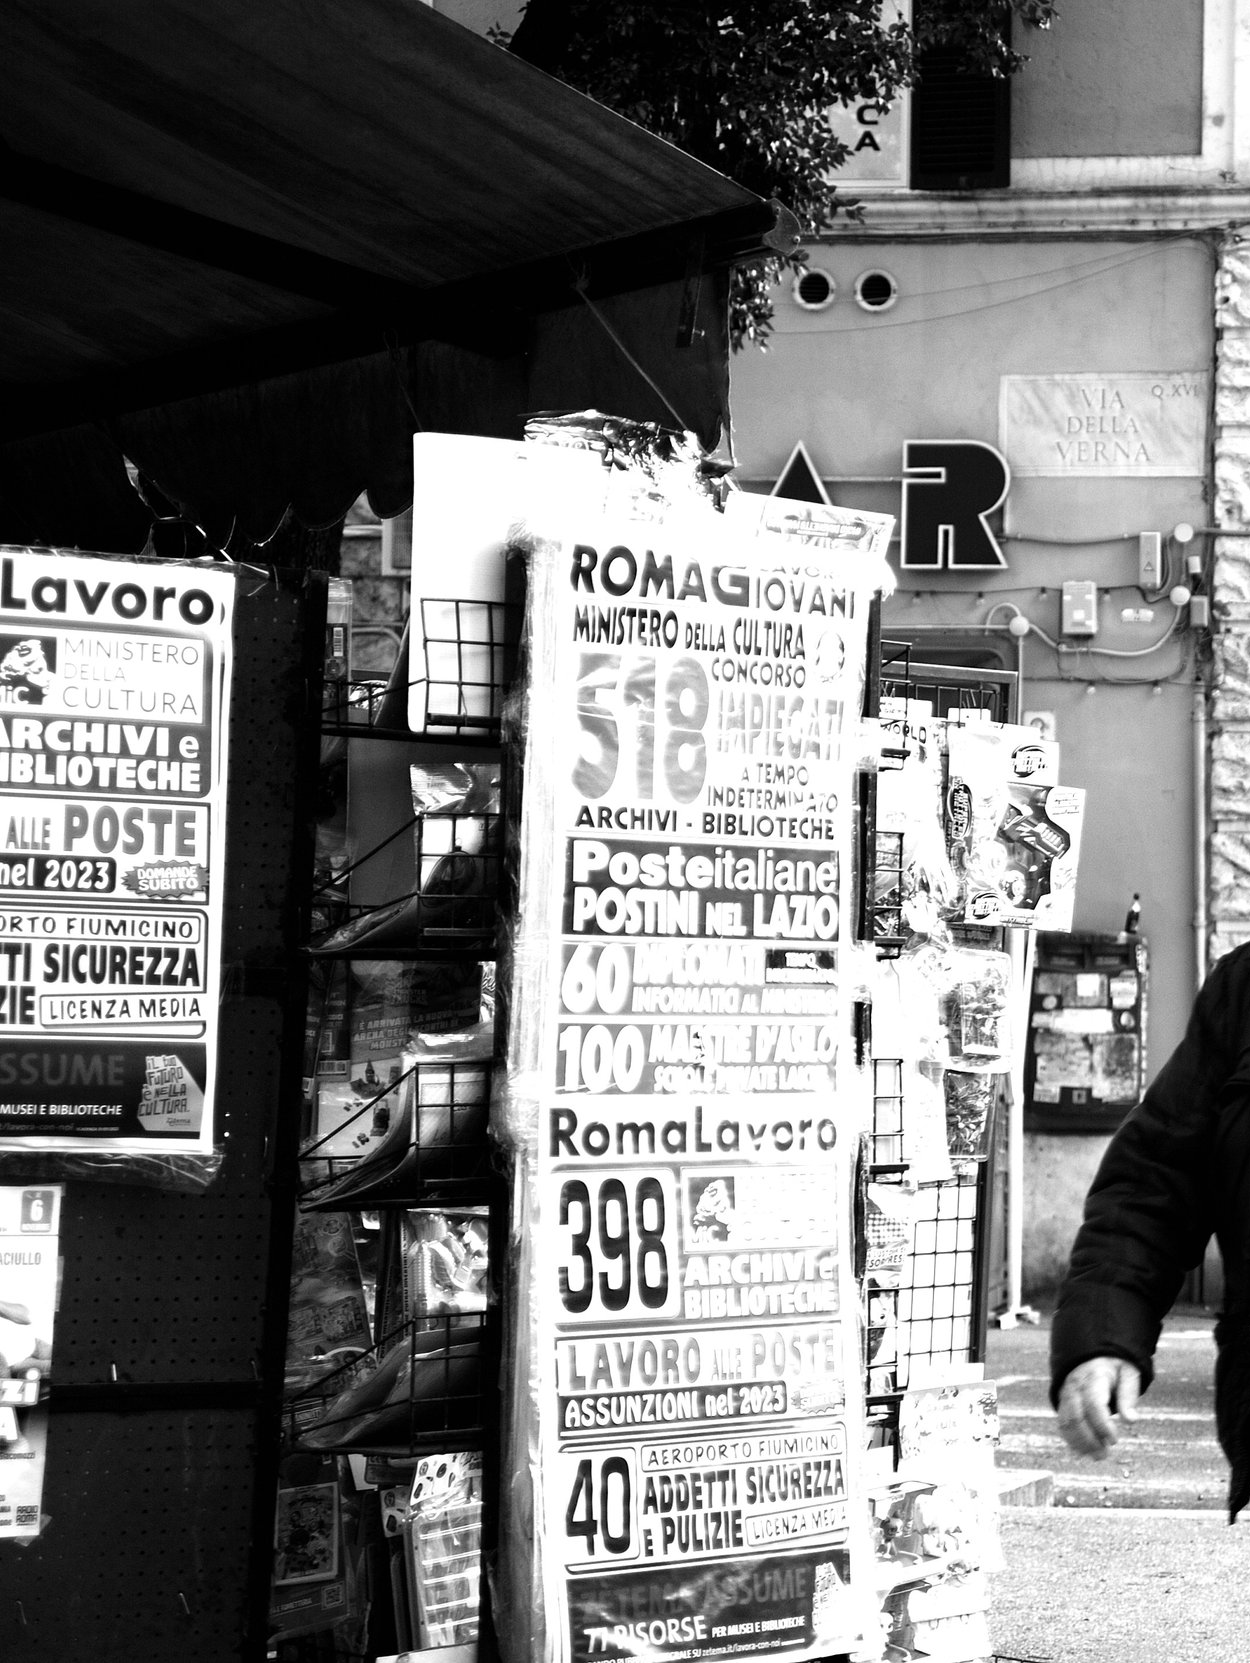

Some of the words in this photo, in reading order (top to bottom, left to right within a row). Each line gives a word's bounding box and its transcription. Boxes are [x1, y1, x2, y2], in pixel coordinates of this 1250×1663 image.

[1081, 388, 1125, 409] VIA
[1067, 415, 1139, 434] DELLA
[1055, 441, 1151, 462] VERNA
[572, 605, 678, 648] MINISTERO
[685, 623, 726, 652] DELLA
[733, 617, 806, 660] CULTURA
[63, 638, 199, 665] MINISTERO
[63, 662, 127, 682] DELLA
[711, 657, 806, 688] CONCORSO
[62, 686, 198, 716] CULTURA
[0, 718, 169, 757] RCHIVI
[179, 736, 200, 758] e
[571, 652, 710, 805] 518
[741, 767, 750, 782] A
[756, 762, 809, 786] TEMPO
[6, 816, 51, 850] ALLE
[64, 804, 196, 857] POSTE
[574, 805, 678, 832] ARCHIVI
[702, 812, 835, 840] BIBLIOTECHE
[44, 860, 109, 889] 2023
[137, 866, 197, 880] DOMANDE
[138, 878, 199, 890] SUBITO
[66, 917, 193, 938] FIUMICINO
[572, 886, 700, 936] POSTINI
[705, 902, 747, 936] NEL
[753, 894, 839, 940] LAZIO
[43, 943, 200, 986] SICUREZZA
[561, 942, 631, 1014] 60
[50, 999, 131, 1020] LICENZA
[139, 998, 201, 1018] MEDIA
[559, 1024, 645, 1093] 100
[0, 1104, 37, 1115] MUSEI
[40, 1104, 46, 1115] E
[49, 1104, 123, 1116] BIBLIOTECHE
[31, 1200, 44, 1221] 6
[558, 1177, 669, 1313] 398
[683, 1252, 815, 1286] ARCHIVI
[684, 1281, 838, 1320] BIBLIOTECHE
[568, 1336, 701, 1391] LAVORO
[711, 1347, 742, 1381] ALLE
[751, 1328, 836, 1378] POSTE
[565, 1390, 700, 1428] ASSUNZIONI
[705, 1388, 733, 1417] nel
[739, 1385, 785, 1415] 2023
[648, 1442, 752, 1466] AEROPORTO
[758, 1434, 839, 1457] FIUMICINO
[643, 1468, 738, 1515] ADDETTI
[746, 1459, 844, 1505] SICUREZZA
[565, 1456, 631, 1556] 40
[661, 1510, 743, 1555] PULIZIE
[752, 1514, 807, 1540] LICENZA
[811, 1506, 846, 1529] MEDA
[613, 1615, 707, 1651] RISORSE
[712, 1626, 727, 1638] PER
[728, 1622, 754, 1637] MUSEI
[755, 1621, 761, 1633] E
[762, 1616, 805, 1632] BIBLIOTECHE
